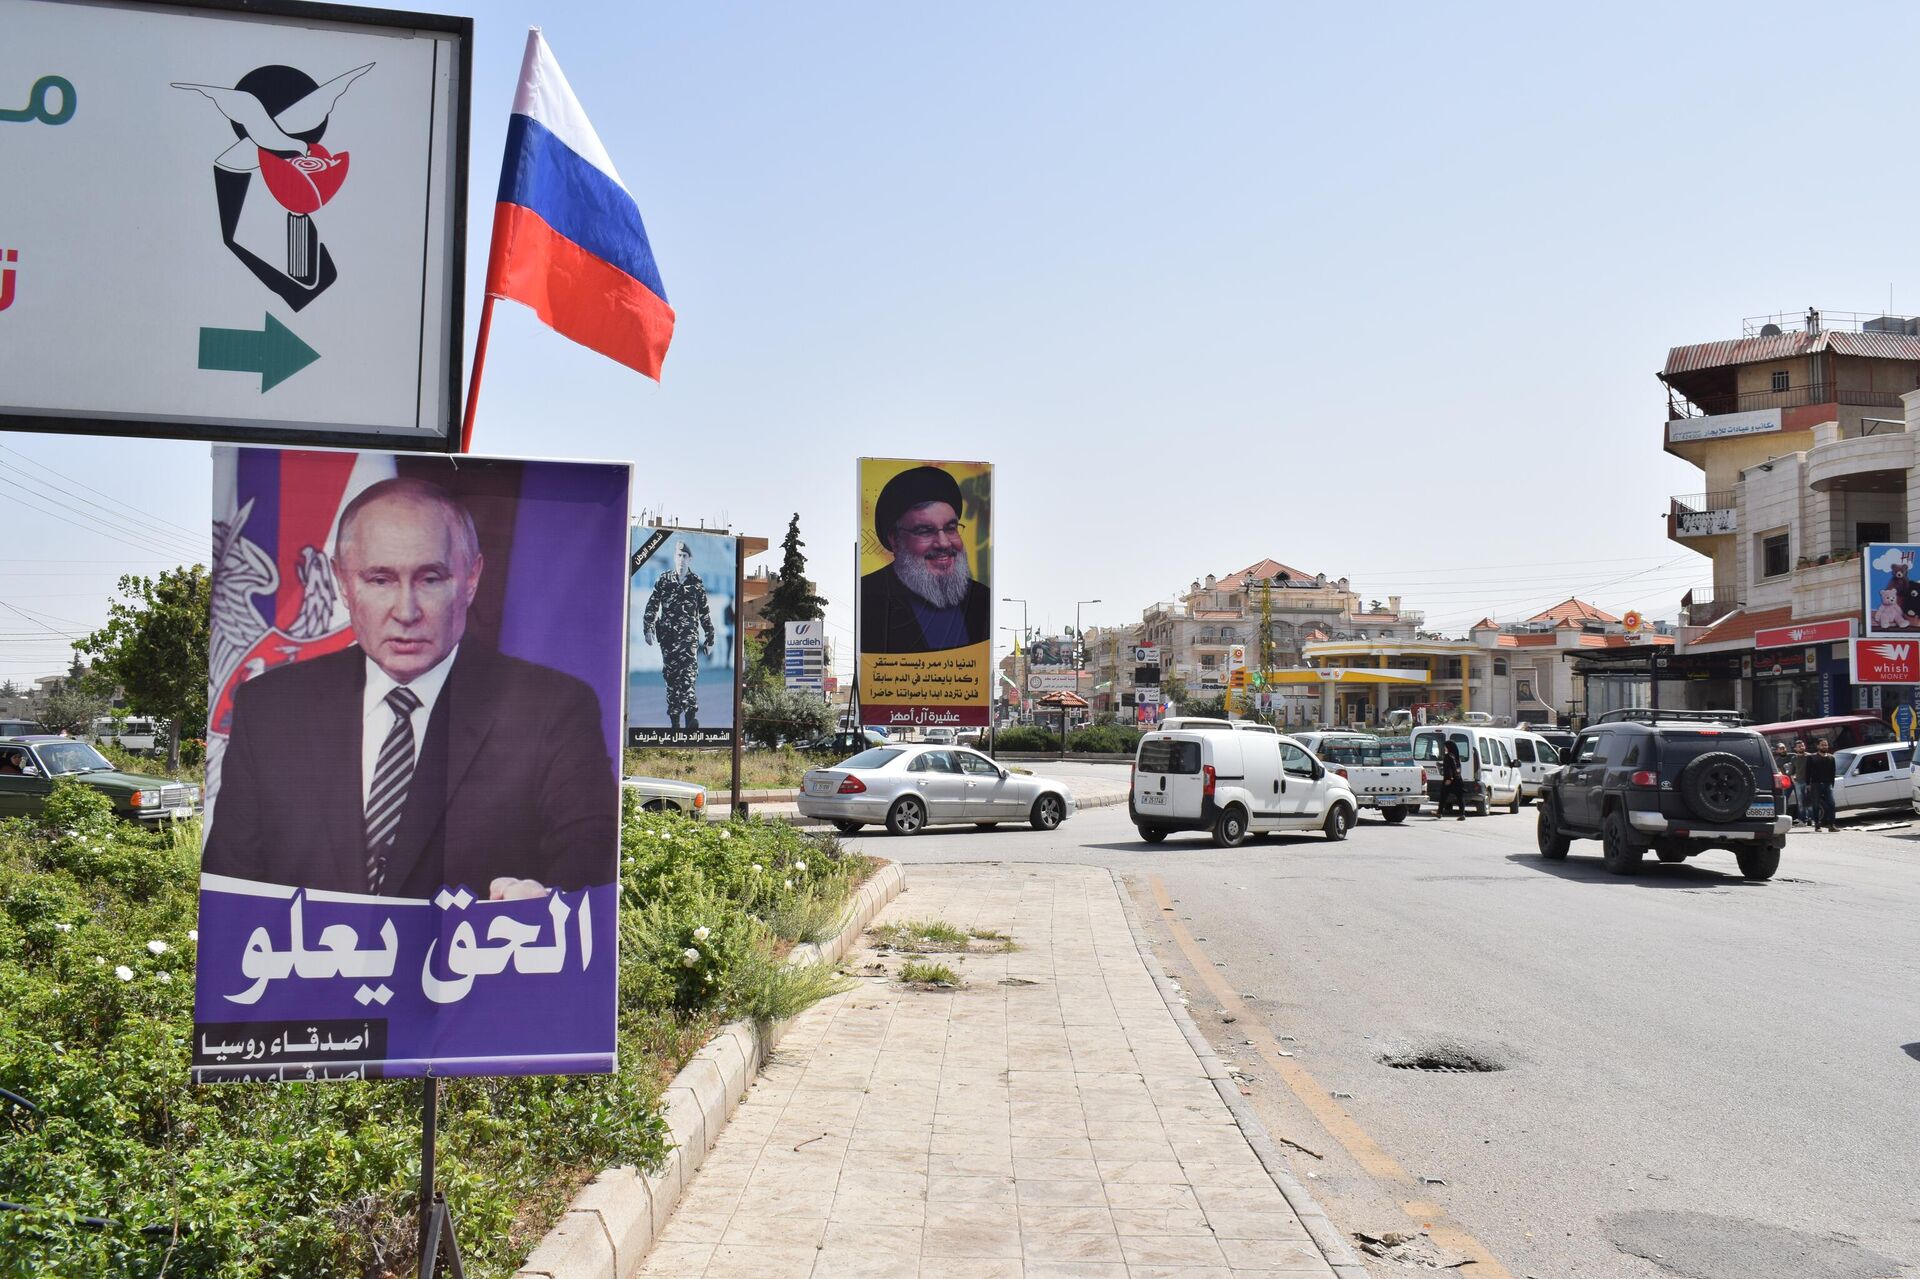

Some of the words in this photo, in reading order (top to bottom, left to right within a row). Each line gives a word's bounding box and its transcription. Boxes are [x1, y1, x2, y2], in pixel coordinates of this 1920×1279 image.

[648, 532, 663, 551] شهيد
[634, 547, 649, 565] الوطن
[787, 638, 820, 646] wardieh
[873, 657, 898, 668] مستقر
[900, 658, 925, 669] وليست
[927, 660, 941, 669] ممر
[943, 659, 953, 669] دار
[955, 659, 976, 670] الدنيا
[1873, 663, 1909, 673] whish
[895, 673, 910, 684] الدم
[922, 674, 952, 685] بايعناك
[954, 674, 972, 683] كما
[944, 688, 962, 699] نتردد
[964, 689, 979, 700] فلن
[889, 707, 915, 723] أمهز
[915, 707, 929, 724] آل
[929, 710, 960, 724] عشيرة
[635, 731, 658, 742] شريف
[659, 732, 671, 744] علي
[672, 732, 687, 742] جلال
[705, 731, 730, 743] الشهيد
[223, 891, 398, 1006] يعلو
[421, 888, 592, 1003] الحق
[270, 1023, 369, 1056] أصدقاء
[202, 1032, 265, 1061] روسيا
